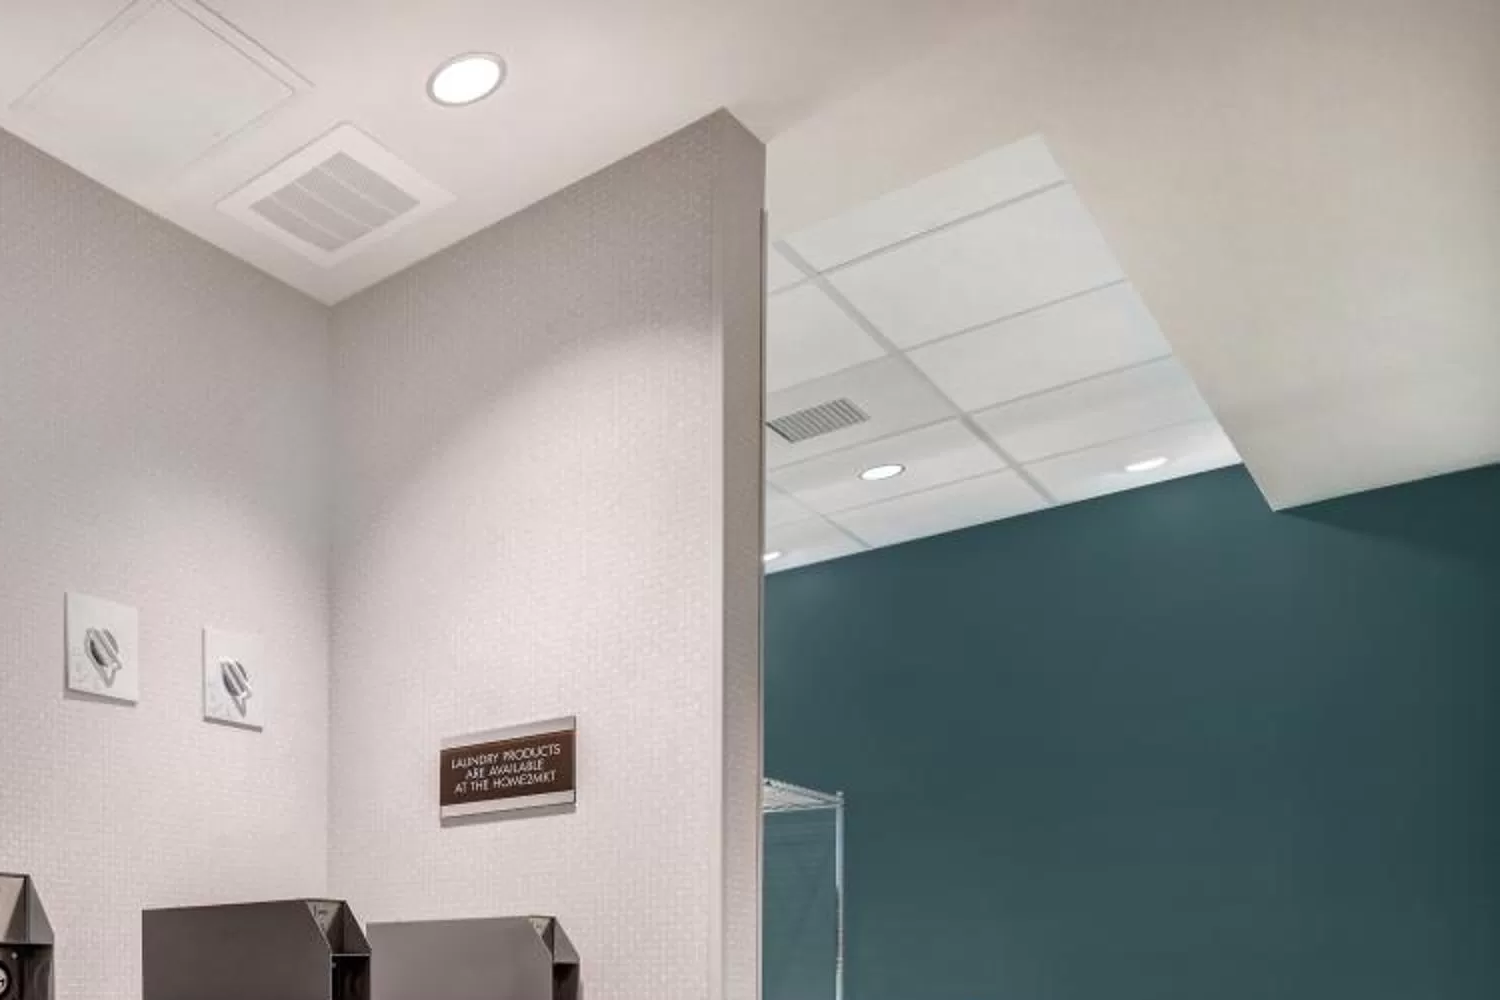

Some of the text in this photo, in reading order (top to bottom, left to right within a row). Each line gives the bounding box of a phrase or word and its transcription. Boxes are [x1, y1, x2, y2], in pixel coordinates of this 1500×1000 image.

[451, 743, 561, 770] LAUNDRY PRODUCTS
[465, 758, 544, 780] ARE AVAILABLE
[453, 769, 557, 796] AT THE HOME2MKT
